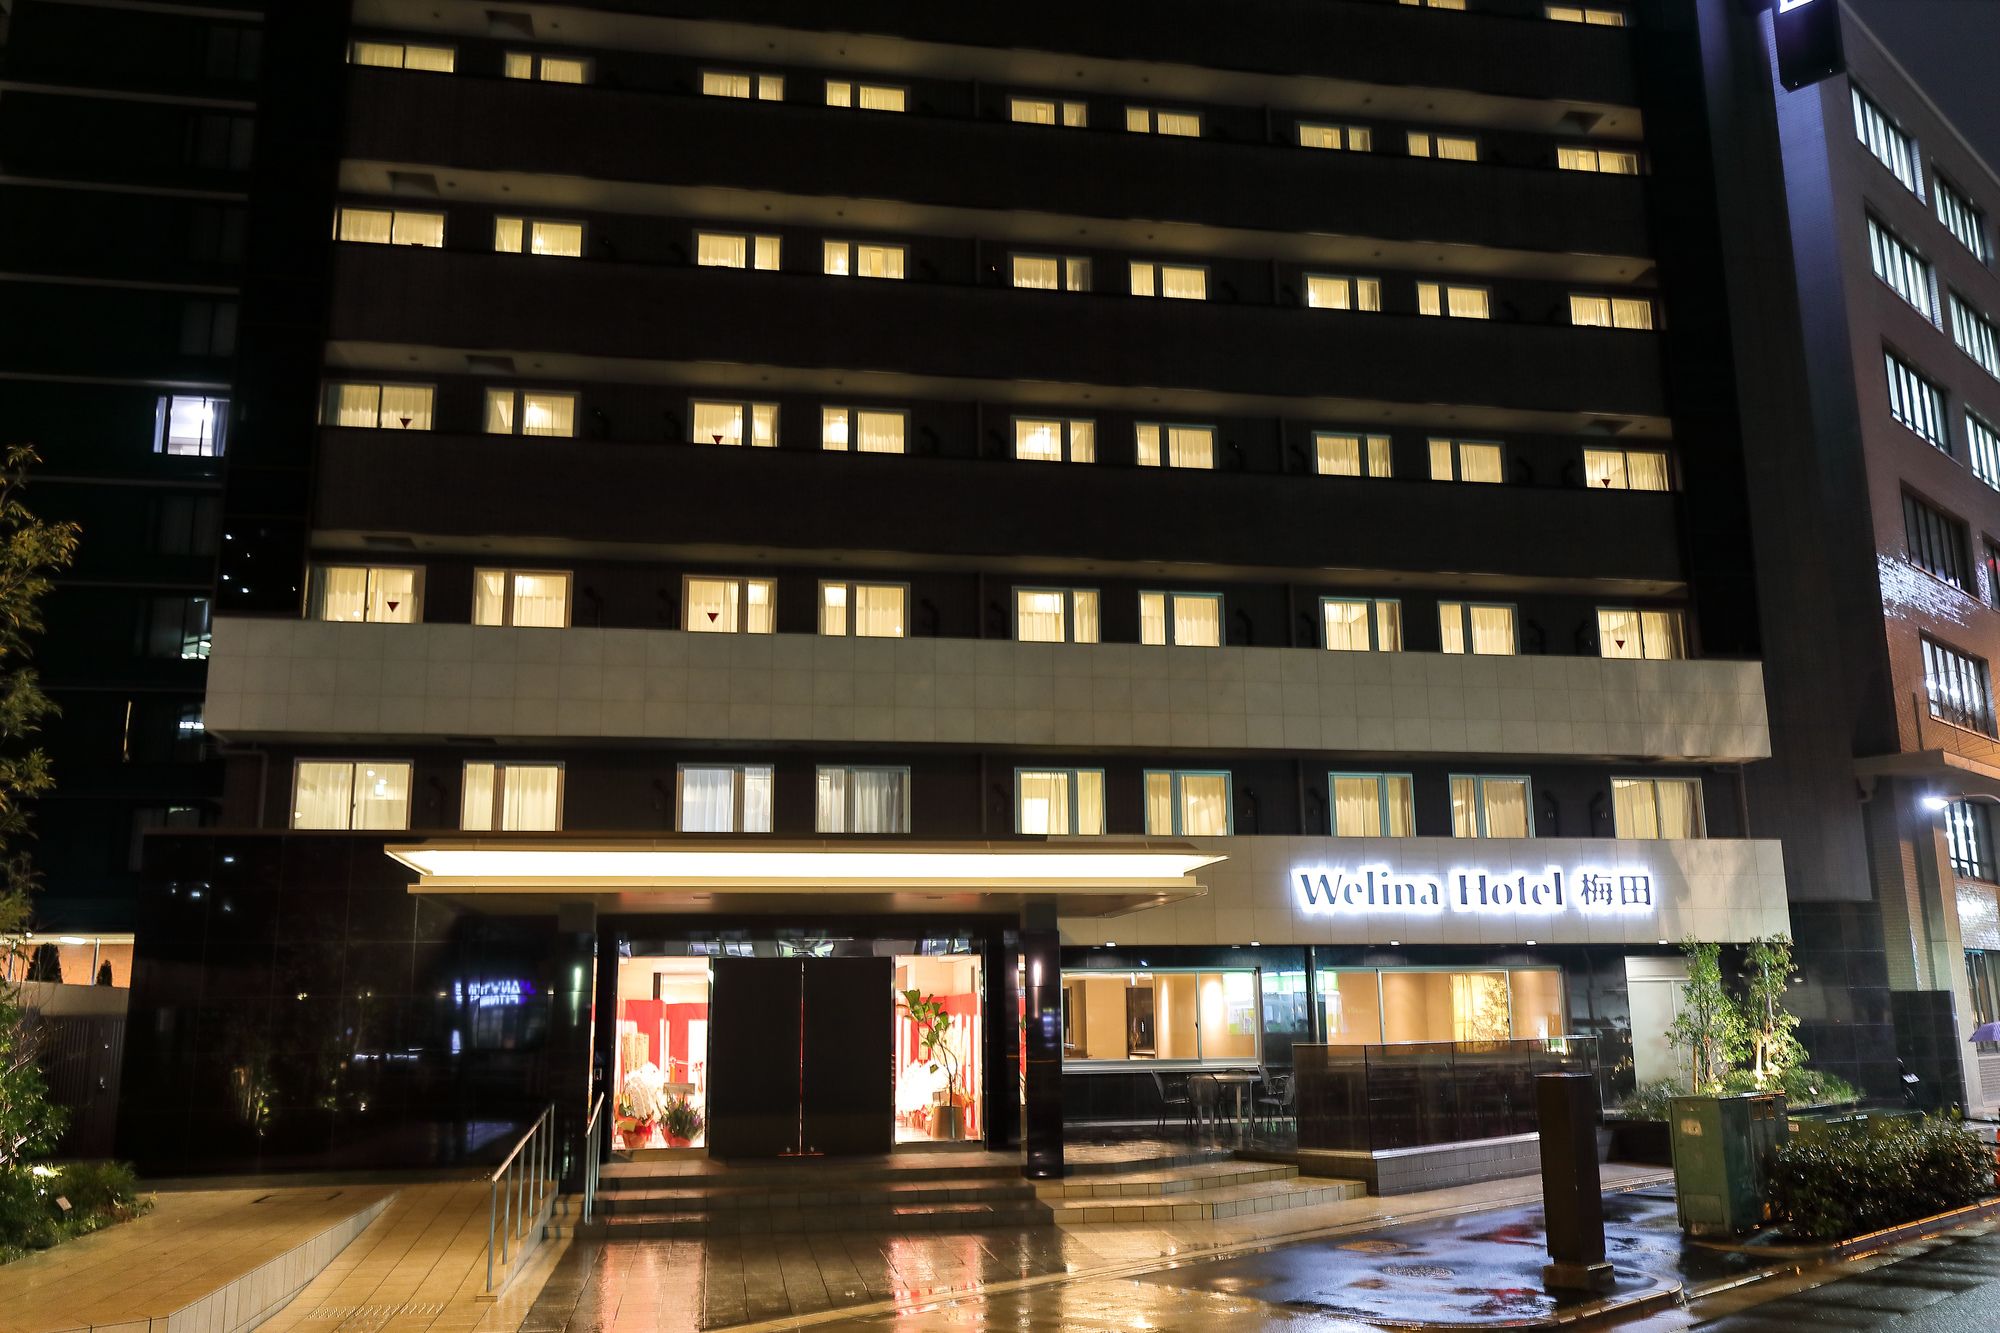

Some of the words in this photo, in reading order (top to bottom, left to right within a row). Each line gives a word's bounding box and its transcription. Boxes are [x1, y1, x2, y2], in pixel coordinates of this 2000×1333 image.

[1299, 871, 1439, 905] Welina
[1458, 872, 1563, 906] Hotel
[1580, 873, 1651, 906] 梅田
